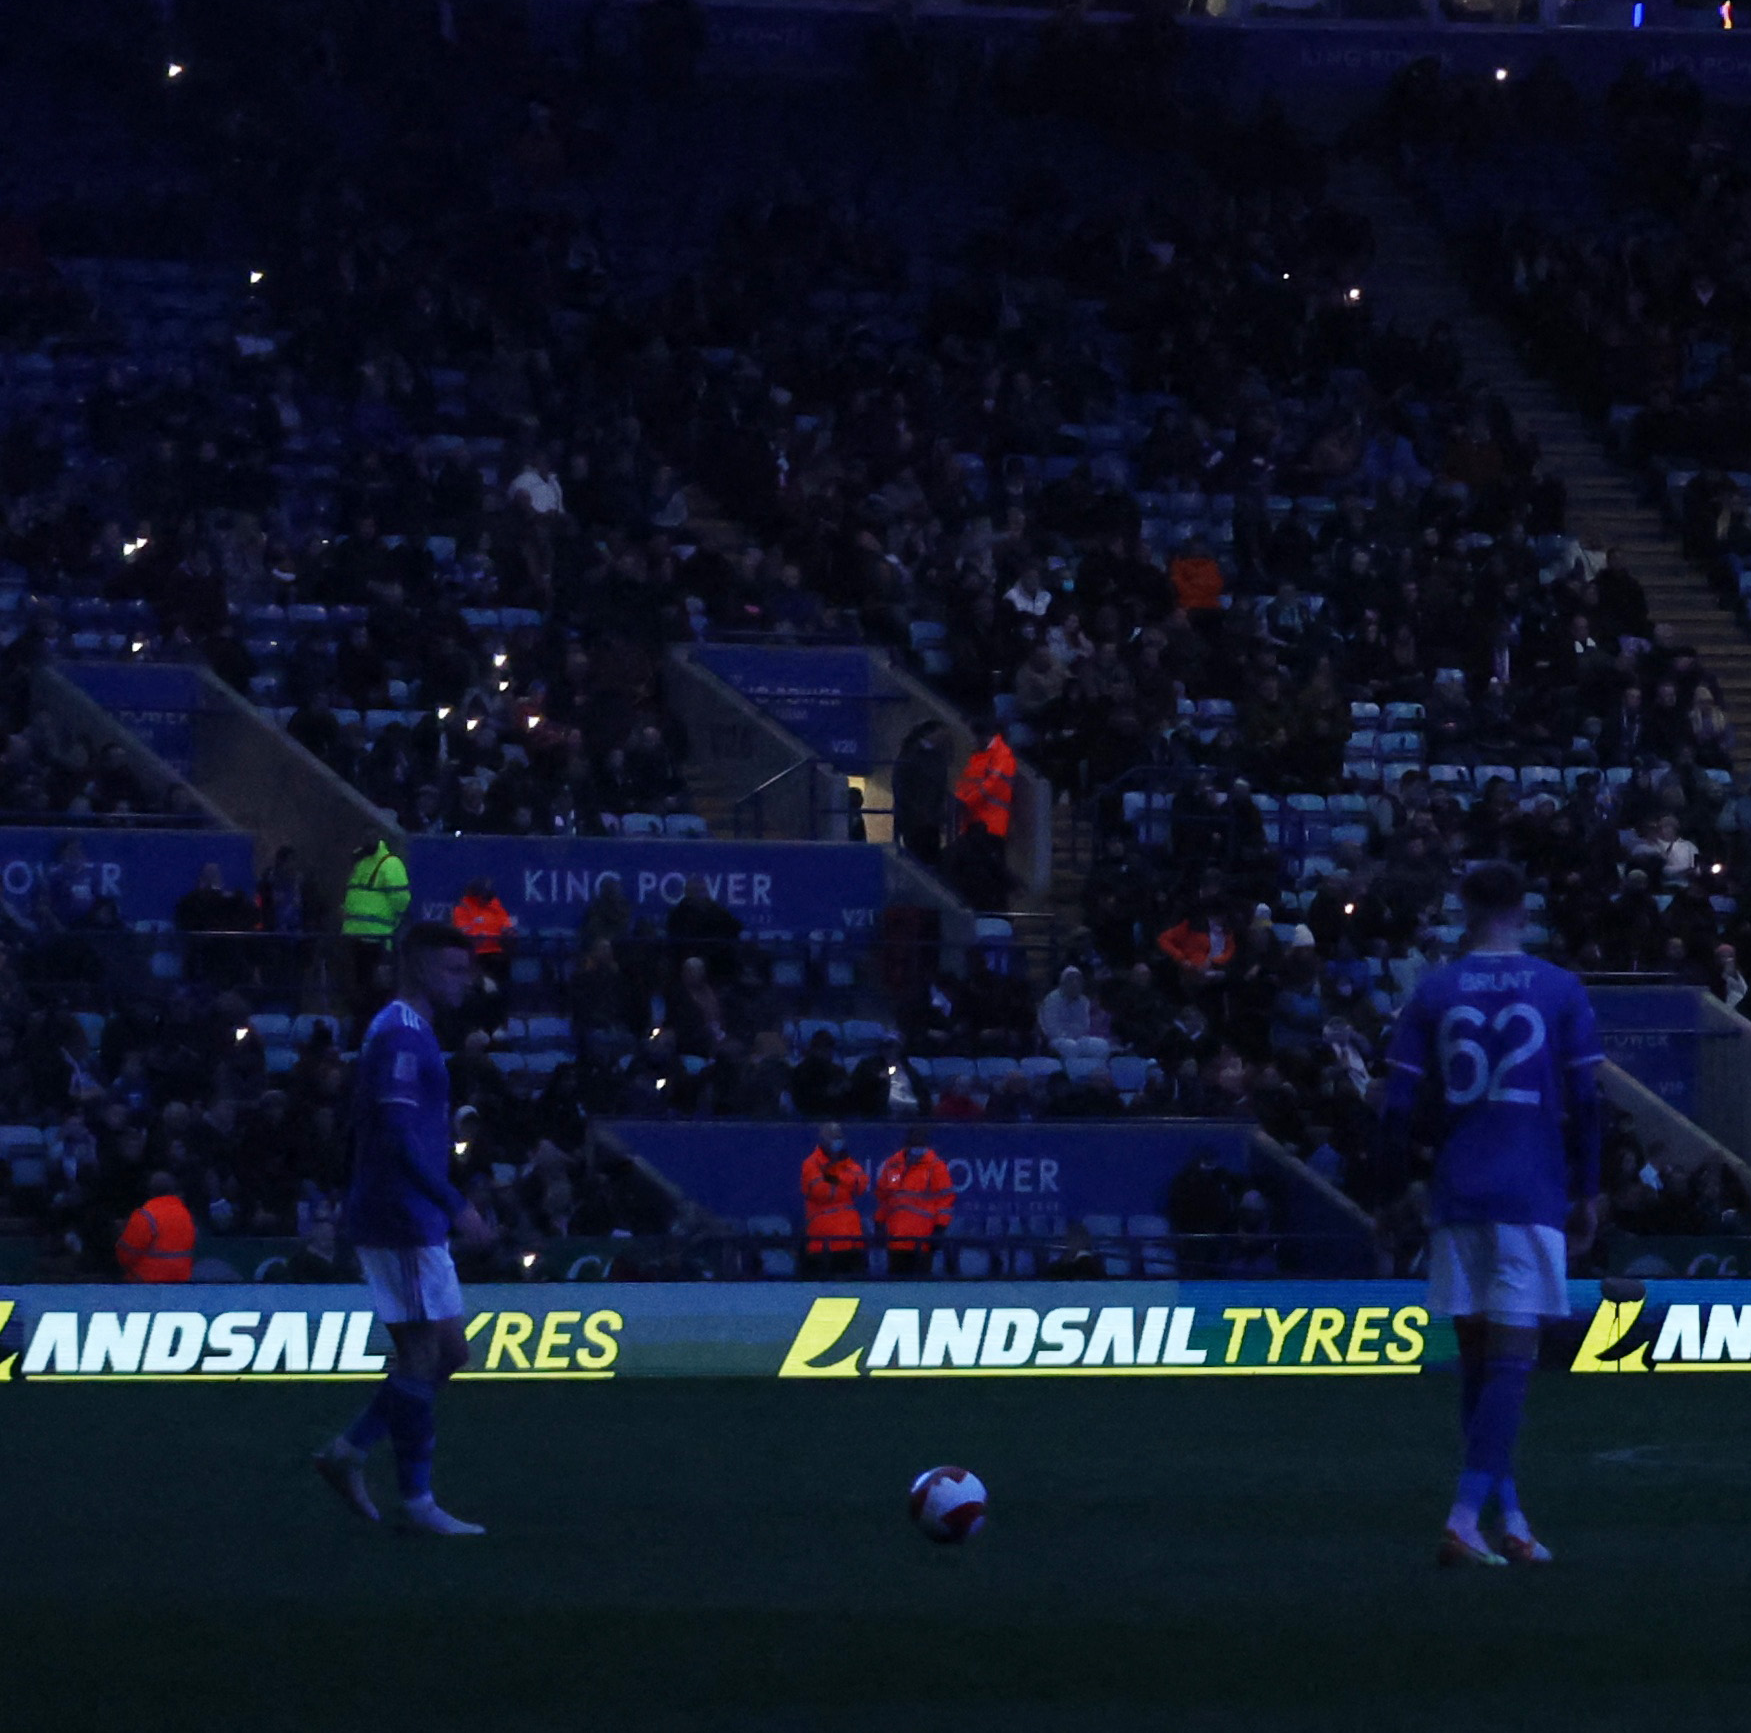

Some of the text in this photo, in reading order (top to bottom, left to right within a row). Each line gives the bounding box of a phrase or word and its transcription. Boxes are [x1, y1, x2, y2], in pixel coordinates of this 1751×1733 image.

[1441, 1003, 1547, 1106] 62
[946, 1157, 1060, 1193] OWER
[464, 1309, 624, 1371] RES
[778, 1297, 1430, 1377] LANDSAIL TYRES
